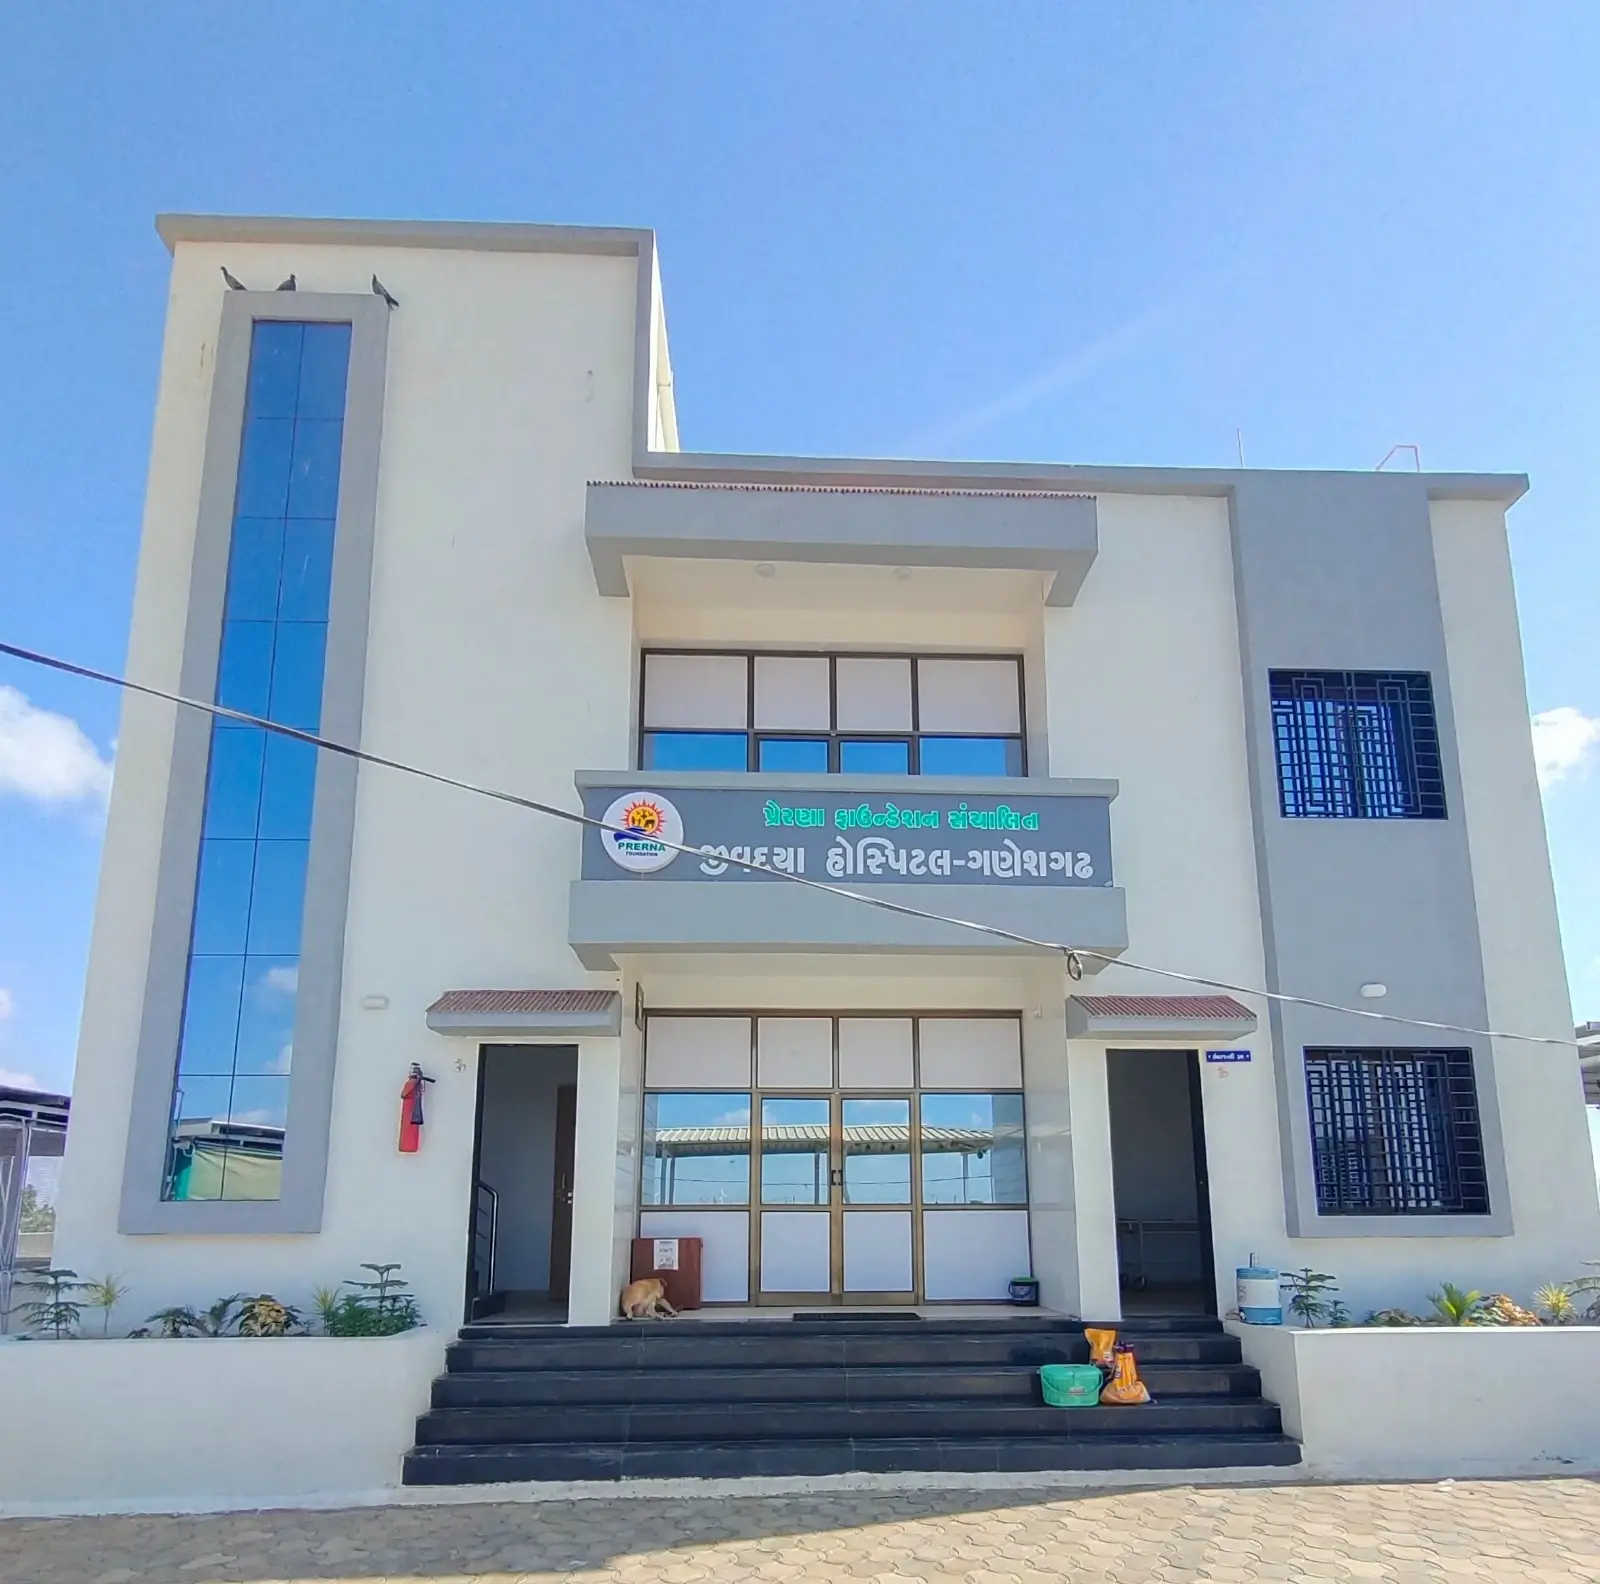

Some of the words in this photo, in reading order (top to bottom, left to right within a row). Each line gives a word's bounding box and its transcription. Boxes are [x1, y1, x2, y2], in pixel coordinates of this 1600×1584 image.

[763, 800, 825, 827] પ્રેરણા
[834, 803, 940, 830] ફાઉન્ડેશન
[948, 802, 1039, 830] સંચાલિત
[618, 842, 666, 852] PRERNA
